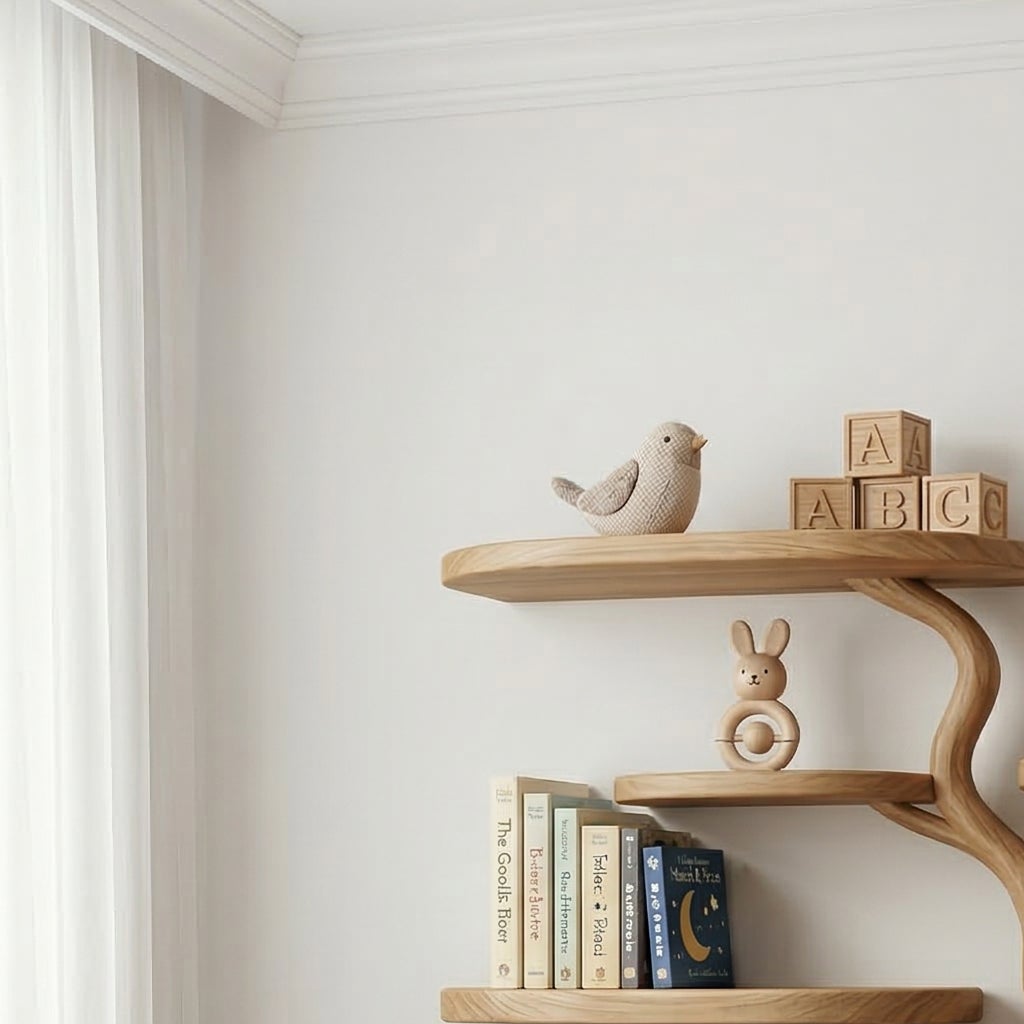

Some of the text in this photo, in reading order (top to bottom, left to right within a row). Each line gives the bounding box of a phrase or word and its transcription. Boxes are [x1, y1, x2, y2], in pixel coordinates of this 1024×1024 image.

[853, 423, 893, 466] A
[906, 426, 928, 470] A
[801, 488, 842, 530] A
[882, 488, 907, 530] B
[934, 484, 970, 528] C
[983, 487, 1001, 530] C
[497, 818, 512, 847] The
